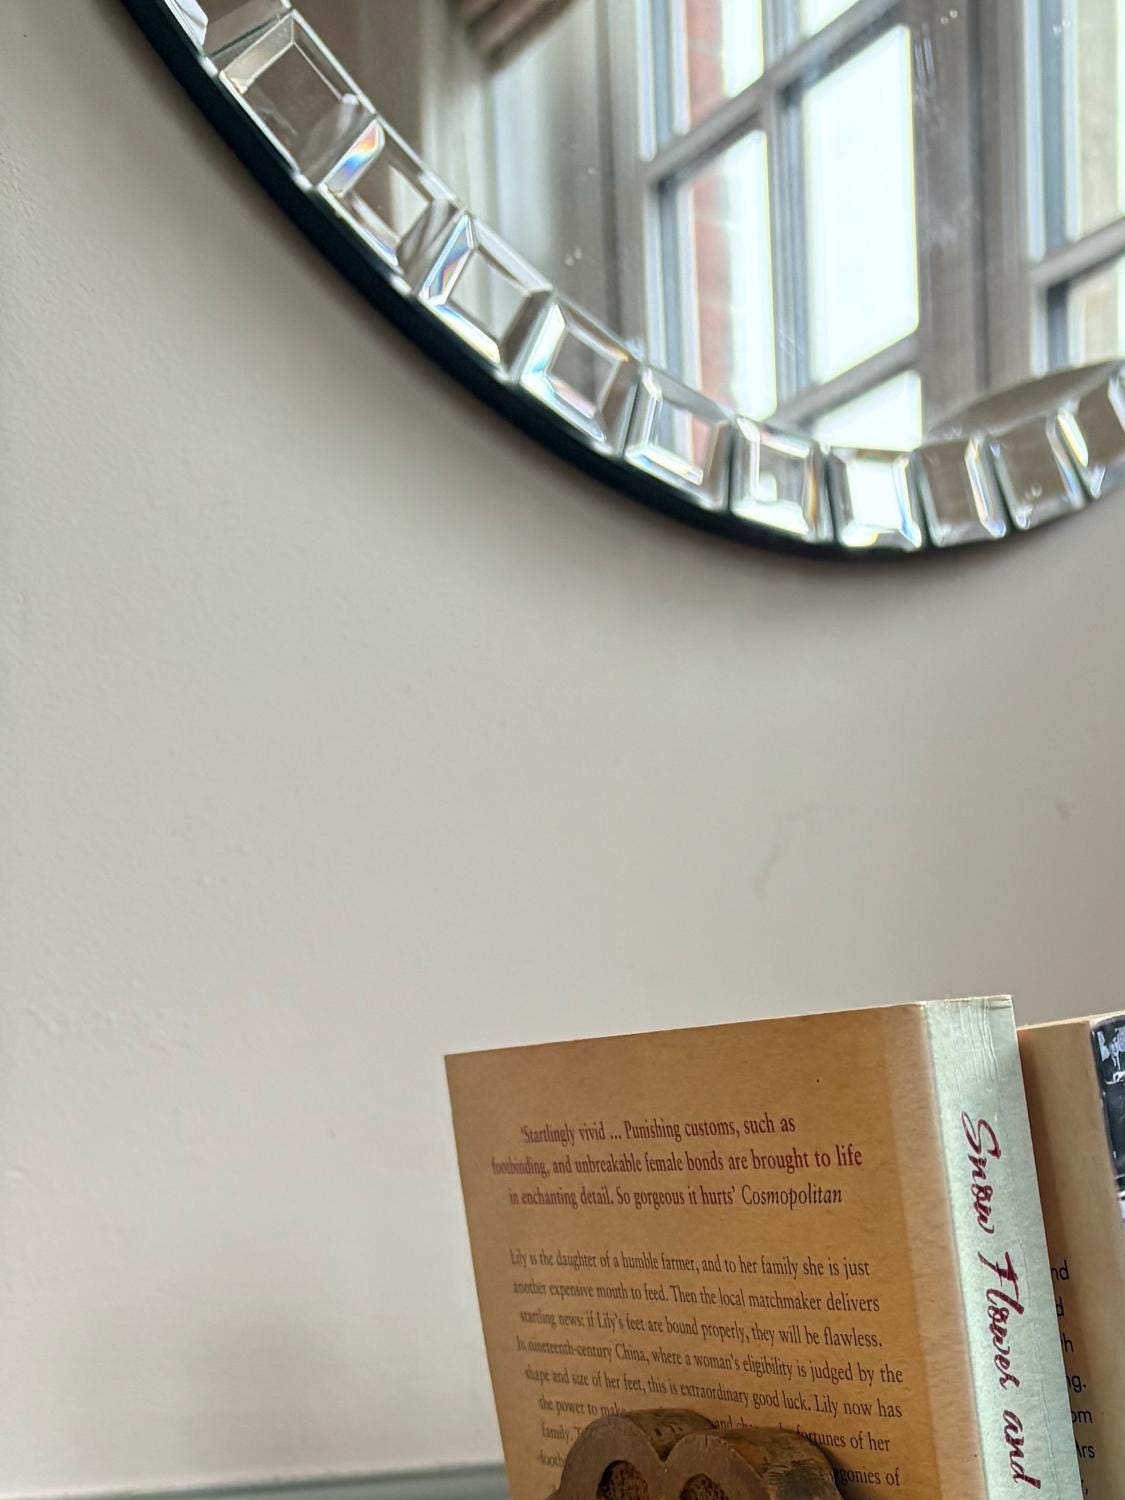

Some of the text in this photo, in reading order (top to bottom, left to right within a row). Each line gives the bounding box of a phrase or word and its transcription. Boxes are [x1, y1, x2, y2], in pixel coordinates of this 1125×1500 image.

[578, 1121, 606, 1141] vivid
[624, 1118, 682, 1143] Punishing
[684, 1119, 740, 1139] customs,
[743, 1112, 775, 1135] such
[780, 1117, 796, 1133] as
[553, 1154, 572, 1174] and
[575, 1153, 642, 1174] unbreakable
[644, 1151, 683, 1172] female
[685, 1150, 724, 1171] bonds
[728, 1156, 748, 1170] are
[750, 1147, 809, 1175] brought
[814, 1150, 831, 1168] to
[835, 1143, 863, 1167] life
[962, 1111, 1001, 1234] Snow
[509, 1182, 843, 1210] in enchanting detail. So gorgeous it hurts' Cosmopolitan
[510, 1248, 870, 1280] Lily is the daughter of a humble farmer, and to her family she is just
[512, 1278, 880, 1312] another expensive mouth to feed. Then the local matchmaker delivers
[520, 1308, 556, 1329] startling
[586, 1310, 594, 1328] if
[597, 1311, 624, 1333] Lily's
[626, 1313, 645, 1331] feet
[648, 1320, 663, 1332] are
[665, 1315, 699, 1335] bound
[701, 1320, 750, 1344] properly,
[751, 1322, 775, 1347] they
[779, 1325, 801, 1344] will
[804, 1325, 819, 1345] be
[824, 1326, 882, 1347] flawless.
[978, 1251, 1024, 1390] Flower
[528, 1339, 612, 1362] nineteenth-century
[615, 1343, 650, 1364] China,
[652, 1346, 682, 1365] where
[685, 1354, 692, 1366] a
[694, 1353, 740, 1370] woman's
[743, 1355, 793, 1381] eligibility
[797, 1360, 807, 1377] is
[810, 1360, 853, 1385] judged
[857, 1362, 875, 1387] by
[880, 1363, 903, 1383] the
[525, 1364, 903, 1418] shape and size of her feet, this is extraordinary good luck. Lily now has
[539, 1394, 553, 1410] the
[556, 1399, 584, 1416] power
[587, 1402, 598, 1416] to
[850, 1430, 865, 1449] of
[869, 1433, 890, 1451] her
[1002, 1409, 1041, 1489] and
[886, 1467, 901, 1486] of
